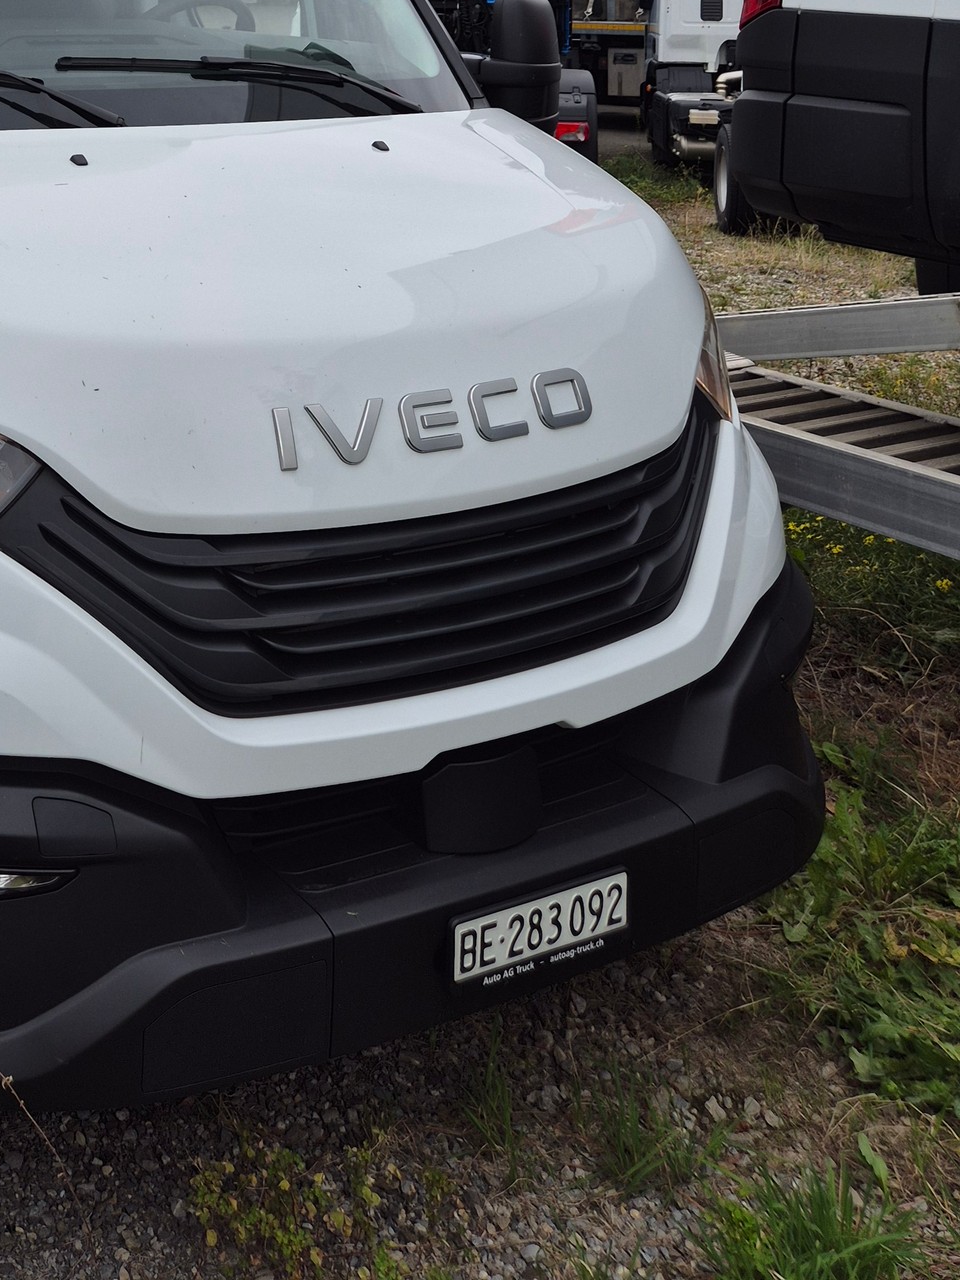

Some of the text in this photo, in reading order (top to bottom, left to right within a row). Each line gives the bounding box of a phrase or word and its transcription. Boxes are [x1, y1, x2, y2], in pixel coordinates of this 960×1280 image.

[271, 367, 593, 471] IVECO
[483, 972, 501, 986] Auto
[503, 968, 514, 980] AG
[515, 961, 535, 977] Truck
[549, 939, 605, 963] autoag-truck.ch
